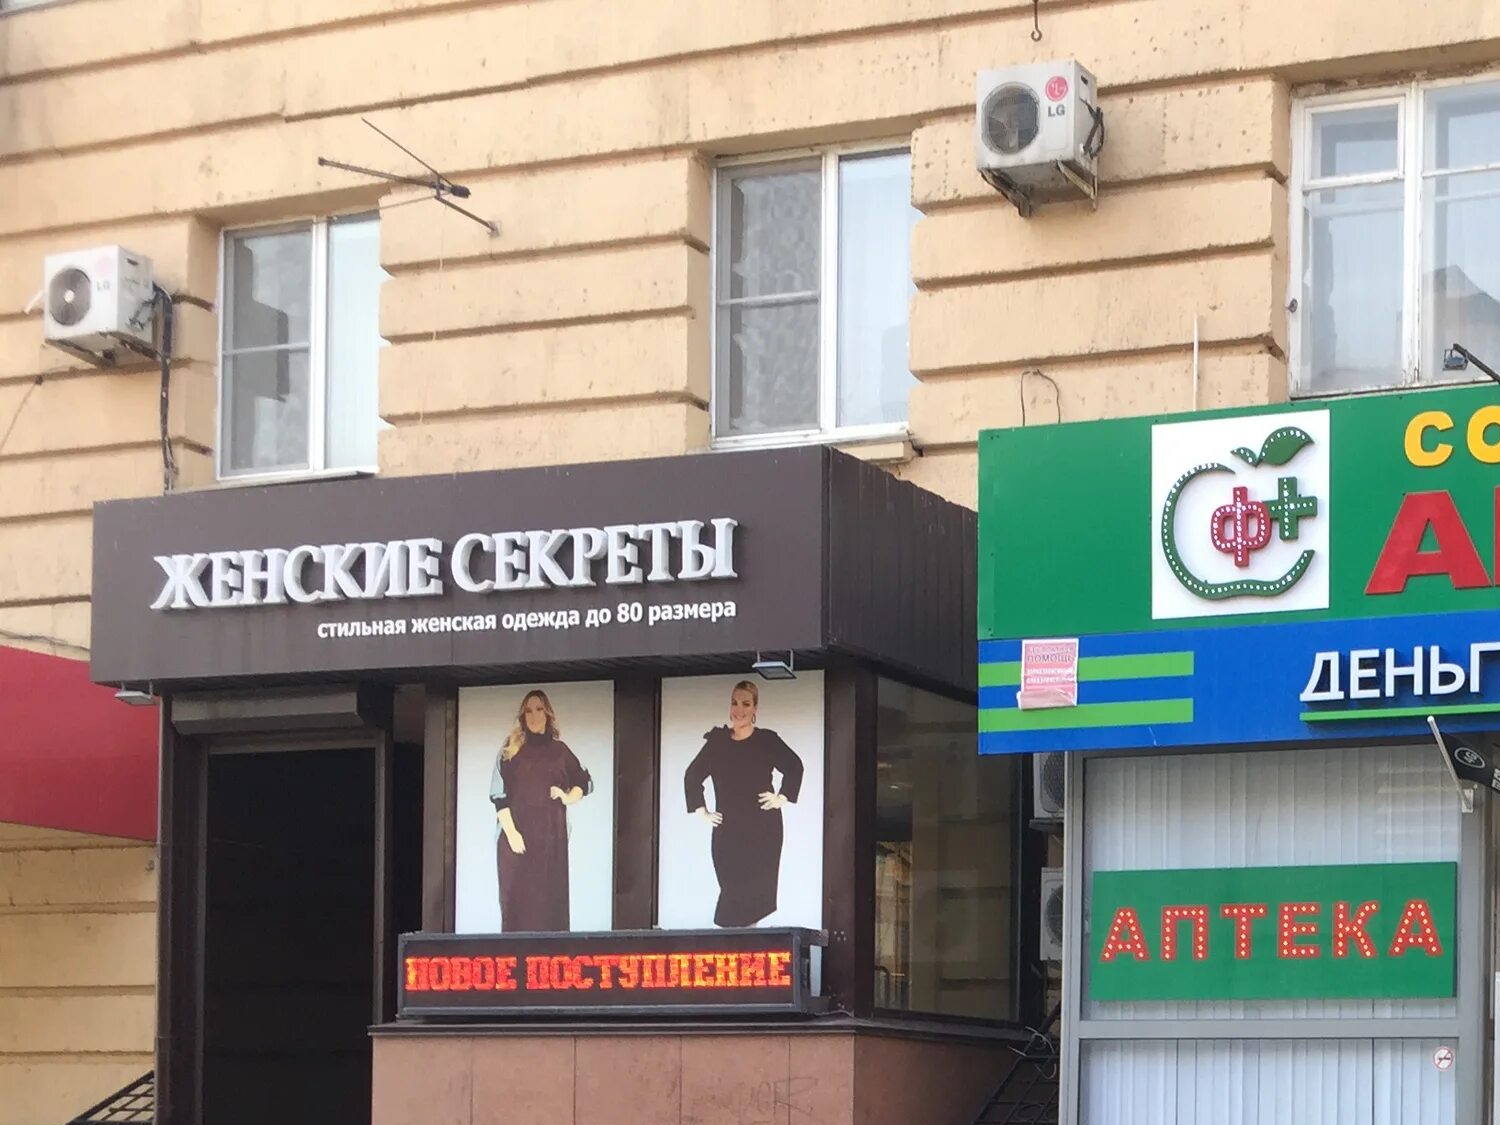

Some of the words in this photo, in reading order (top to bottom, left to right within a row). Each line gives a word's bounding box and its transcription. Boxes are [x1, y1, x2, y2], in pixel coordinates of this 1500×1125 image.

[1048, 105, 1065, 117] LG
[151, 537, 444, 610] ЖЕНСКИЕ
[451, 517, 739, 594] СЕКРЕТЫ
[317, 617, 406, 639] стильная
[411, 614, 497, 633] женская
[502, 608, 580, 631] одежда
[585, 607, 612, 627] до
[617, 603, 643, 624] 80
[648, 600, 737, 626] размера
[1102, 899, 1443, 962] АПТЕКА
[405, 956, 517, 991] НОВОЕ
[526, 952, 791, 990] ПОСТУПЛЕНИЕ
